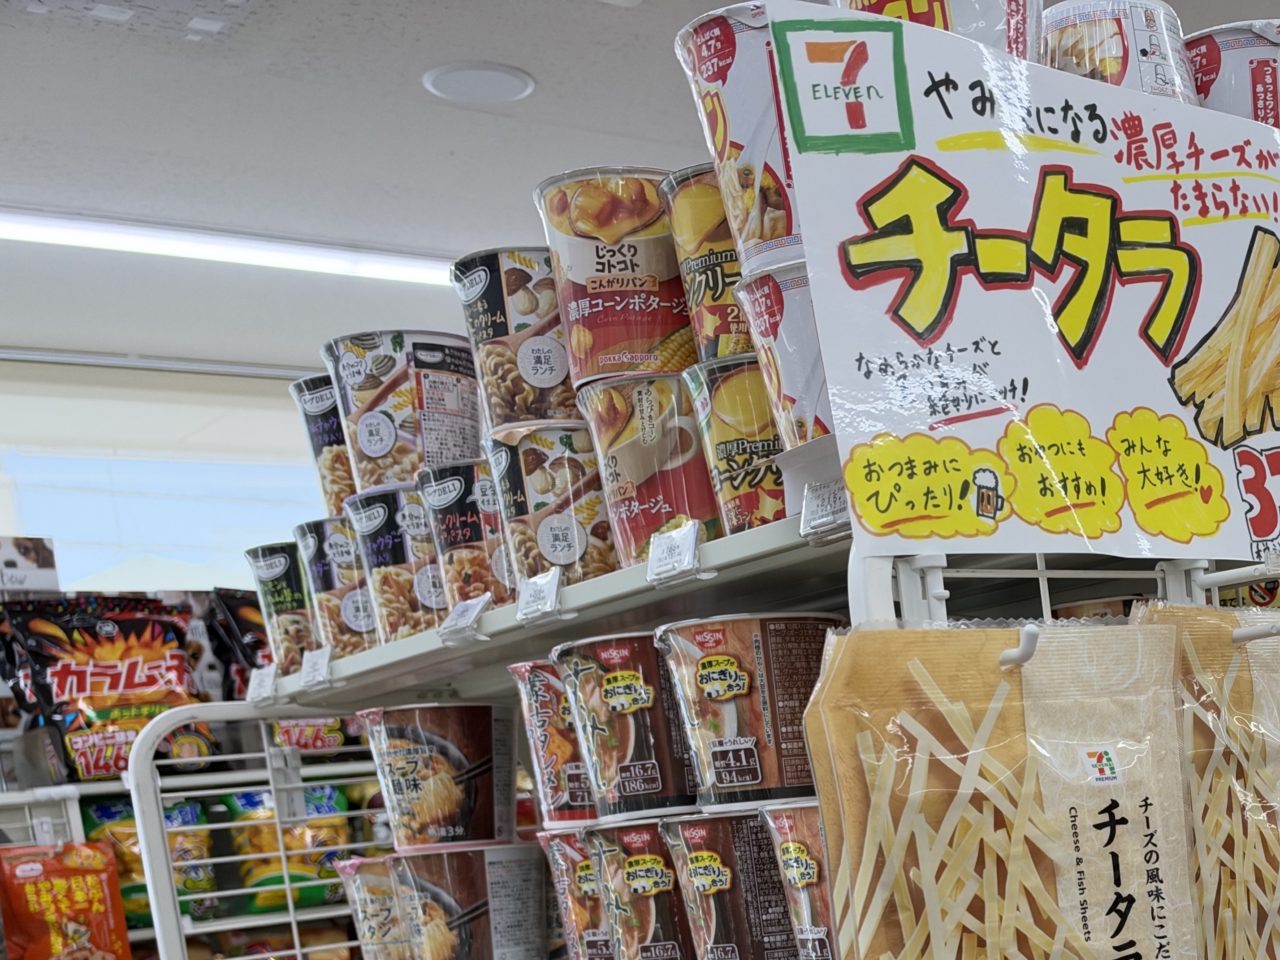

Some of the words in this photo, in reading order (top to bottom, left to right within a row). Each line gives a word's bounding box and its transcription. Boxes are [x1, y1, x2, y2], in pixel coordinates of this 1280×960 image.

[1110, 111, 1280, 174] 濃厚チーズが
[595, 245, 638, 259] じっくり
[840, 153, 1202, 369] チータラ
[595, 259, 640, 273] コトコト
[590, 276, 648, 291] こんがりパン
[531, 365, 556, 376] ランチ
[533, 355, 552, 366] 満足
[1016, 438, 1086, 464] おやつにも
[1120, 434, 1172, 454] みんな
[863, 456, 961, 483] おつまみに
[1137, 463, 1201, 493] 大好き!
[866, 479, 970, 513] ぴったり!
[1038, 471, 1106, 505] おすすめ!
[549, 543, 575, 554] ランチ
[551, 532, 570, 543] 満足
[698, 670, 747, 684] おにぎりに
[1068, 806, 1081, 853] Cheese
[1076, 870, 1086, 896] Fish
[1079, 900, 1091, 942] Sheets
